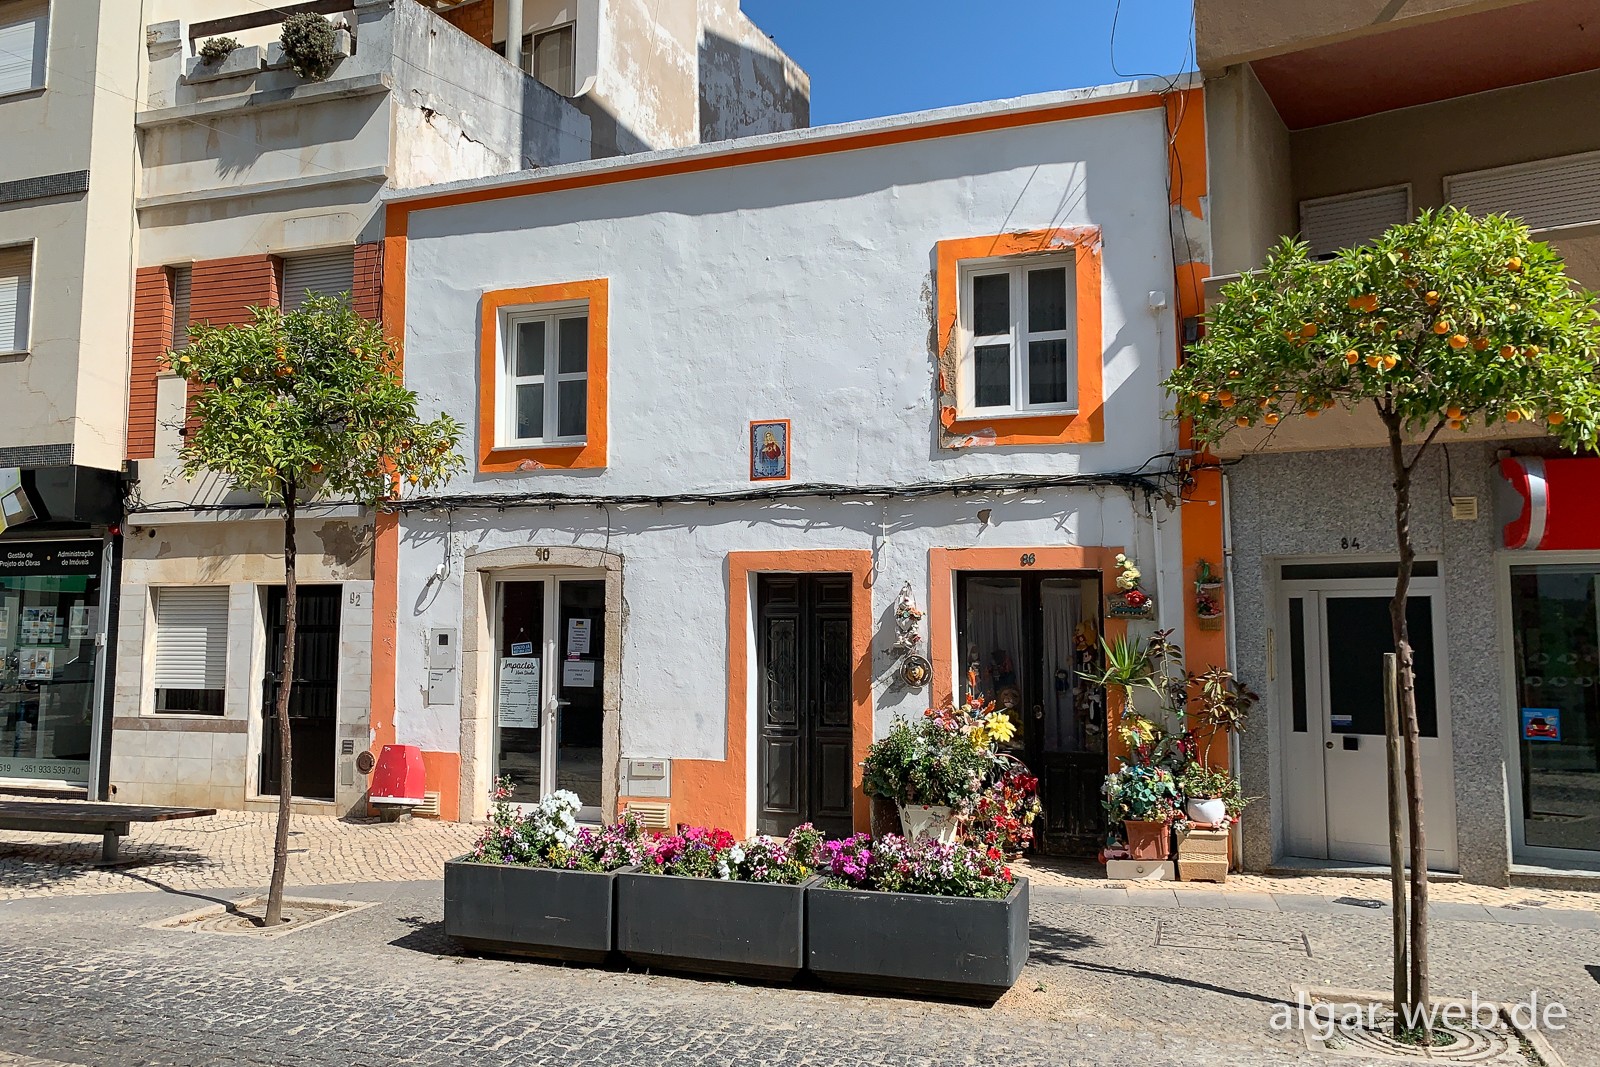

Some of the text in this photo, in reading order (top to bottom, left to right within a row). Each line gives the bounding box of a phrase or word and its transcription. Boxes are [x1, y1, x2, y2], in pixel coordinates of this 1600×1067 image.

[1341, 537, 1360, 550] 84
[57, 550, 94, 558] Administração
[535, 547, 550, 561] 90
[1020, 553, 1035, 567] 86
[350, 592, 361, 606] 92
[20, 765, 36, 773] +351
[38, 766, 51, 774] 933
[52, 766, 66, 774] 539
[67, 767, 80, 775] 740
